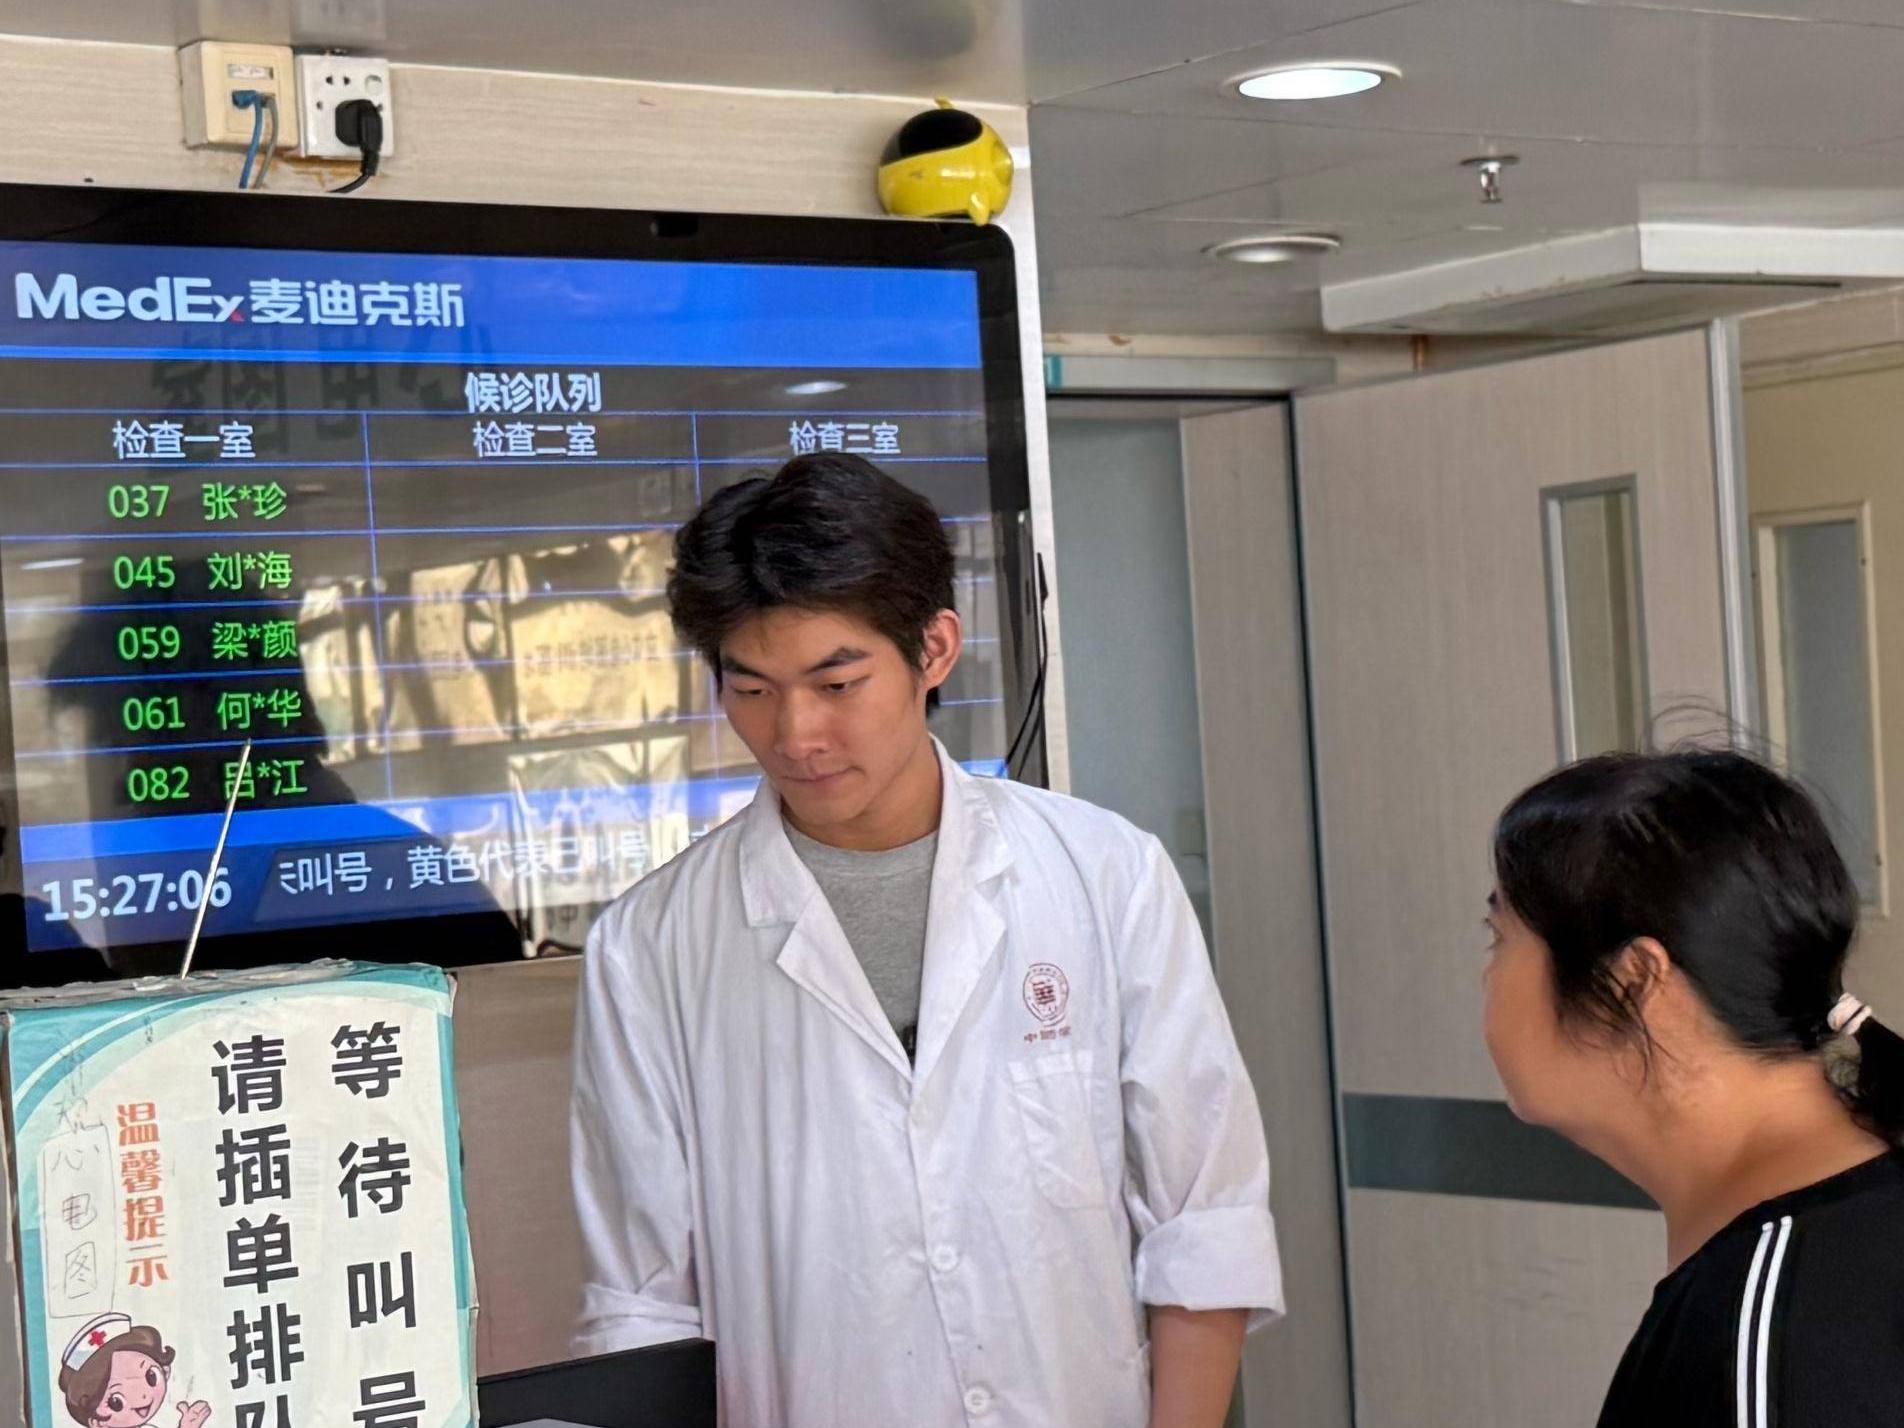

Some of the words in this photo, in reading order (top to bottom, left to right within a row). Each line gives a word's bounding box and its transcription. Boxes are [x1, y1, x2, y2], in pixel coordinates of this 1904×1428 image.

[463, 372, 602, 413] 候诊队列
[113, 420, 256, 459] 检查一室
[472, 420, 598, 457] 检查二室
[789, 420, 901, 455] 检查三室
[108, 485, 170, 518] 037
[114, 556, 176, 589] 045
[118, 625, 180, 660] 059
[123, 696, 186, 731] 061
[128, 766, 190, 802] 082
[42, 866, 232, 921] 15:27:06
[118, 1101, 169, 1287] 温馨提示
